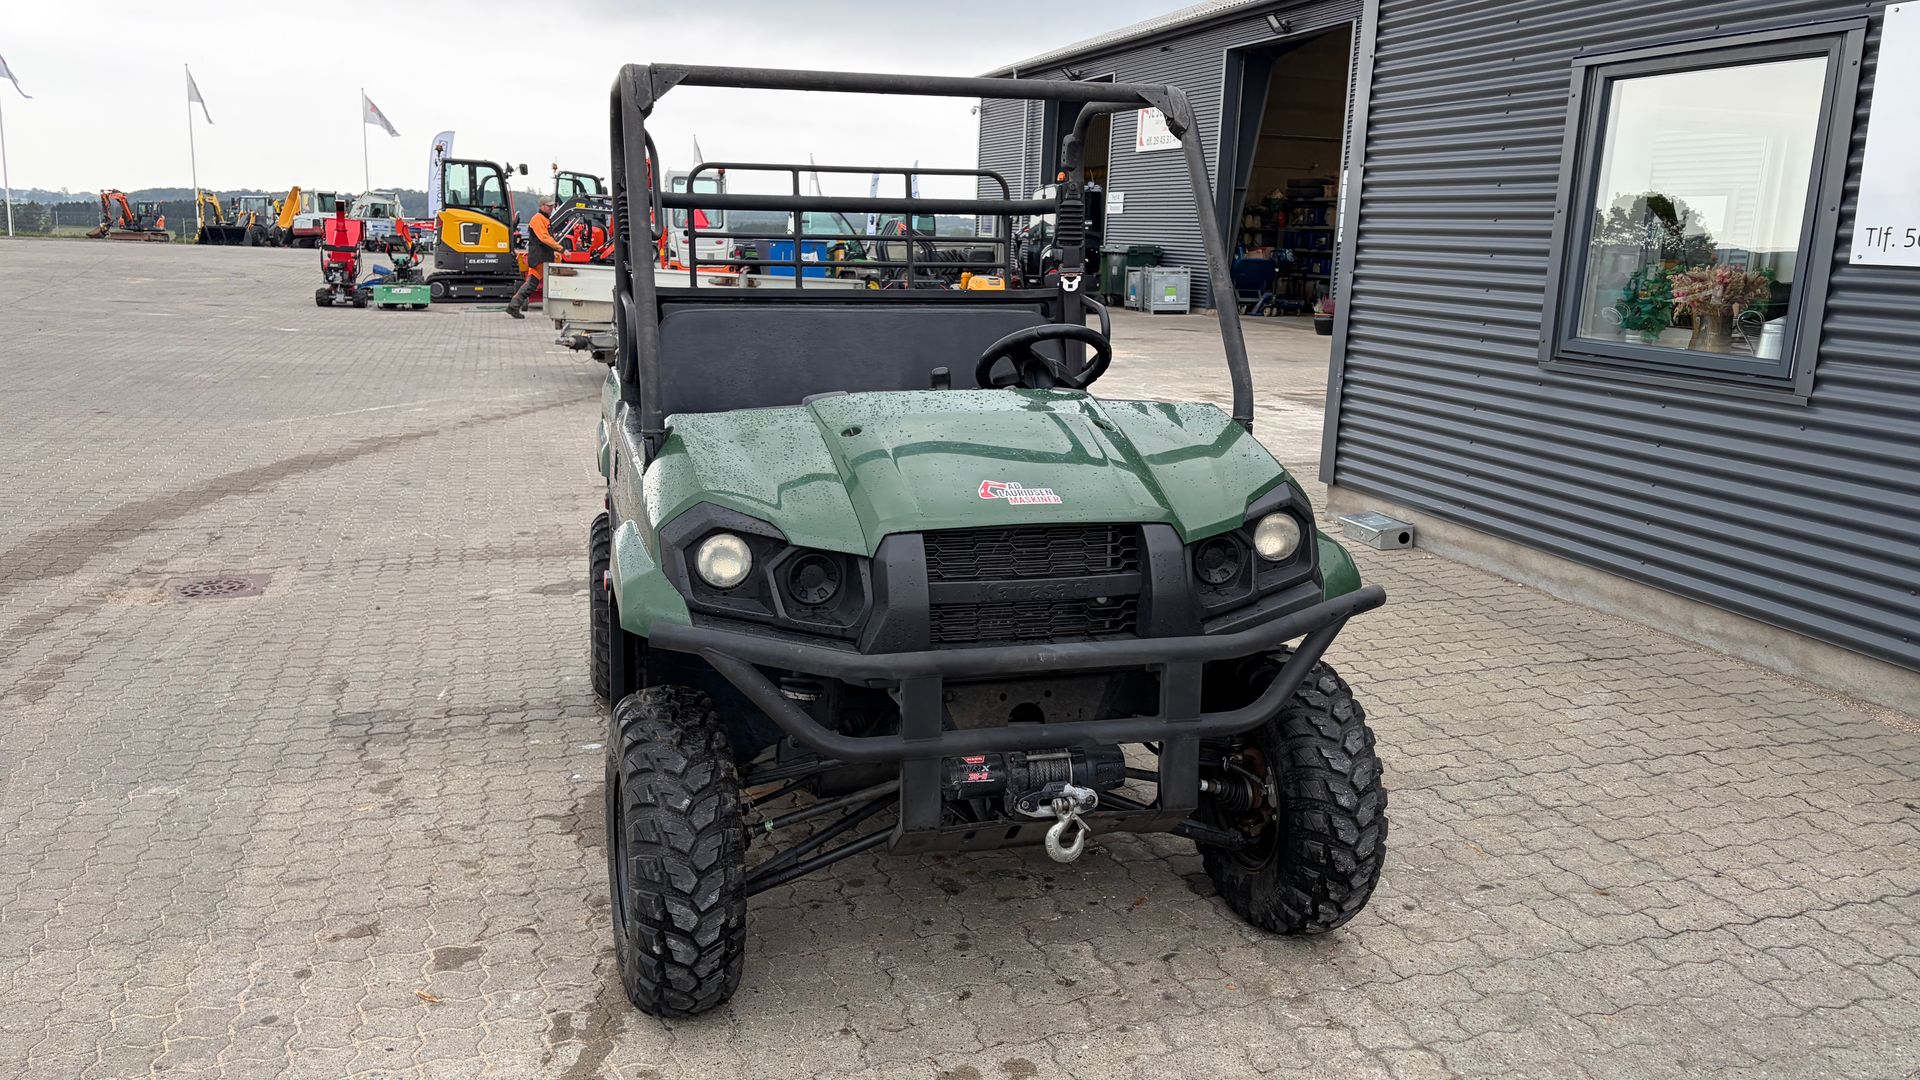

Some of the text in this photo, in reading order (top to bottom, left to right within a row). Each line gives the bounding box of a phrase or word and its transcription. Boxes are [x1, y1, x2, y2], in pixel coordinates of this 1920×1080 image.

[1865, 226, 1920, 252] Tlf. 5
[999, 489, 1053, 497] LAURIDSEN
[1009, 496, 1061, 504] MASKINER
